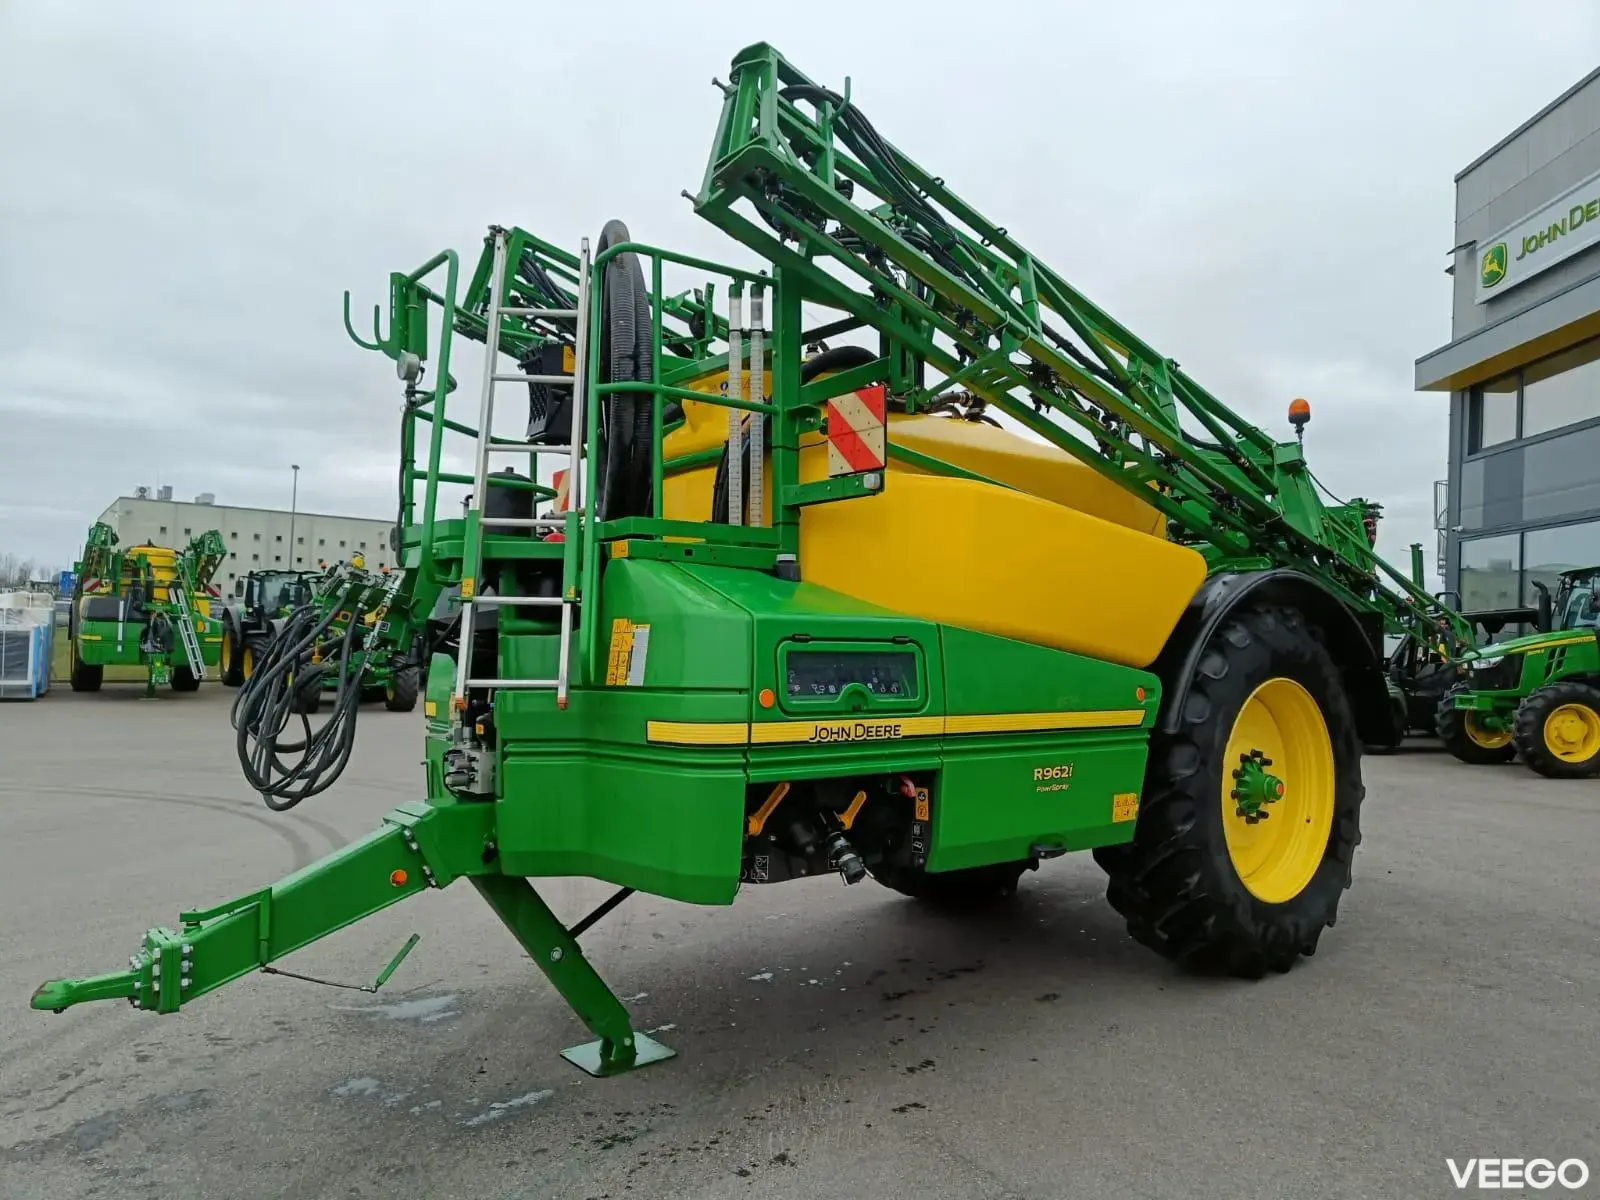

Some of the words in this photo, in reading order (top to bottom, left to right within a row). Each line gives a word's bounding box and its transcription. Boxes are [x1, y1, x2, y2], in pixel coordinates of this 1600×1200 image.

[1516, 218, 1567, 261] JOHN
[1569, 197, 1600, 231] DE
[809, 725, 851, 741] JOHN
[854, 723, 902, 738] DEERE
[1033, 762, 1074, 781] R962i
